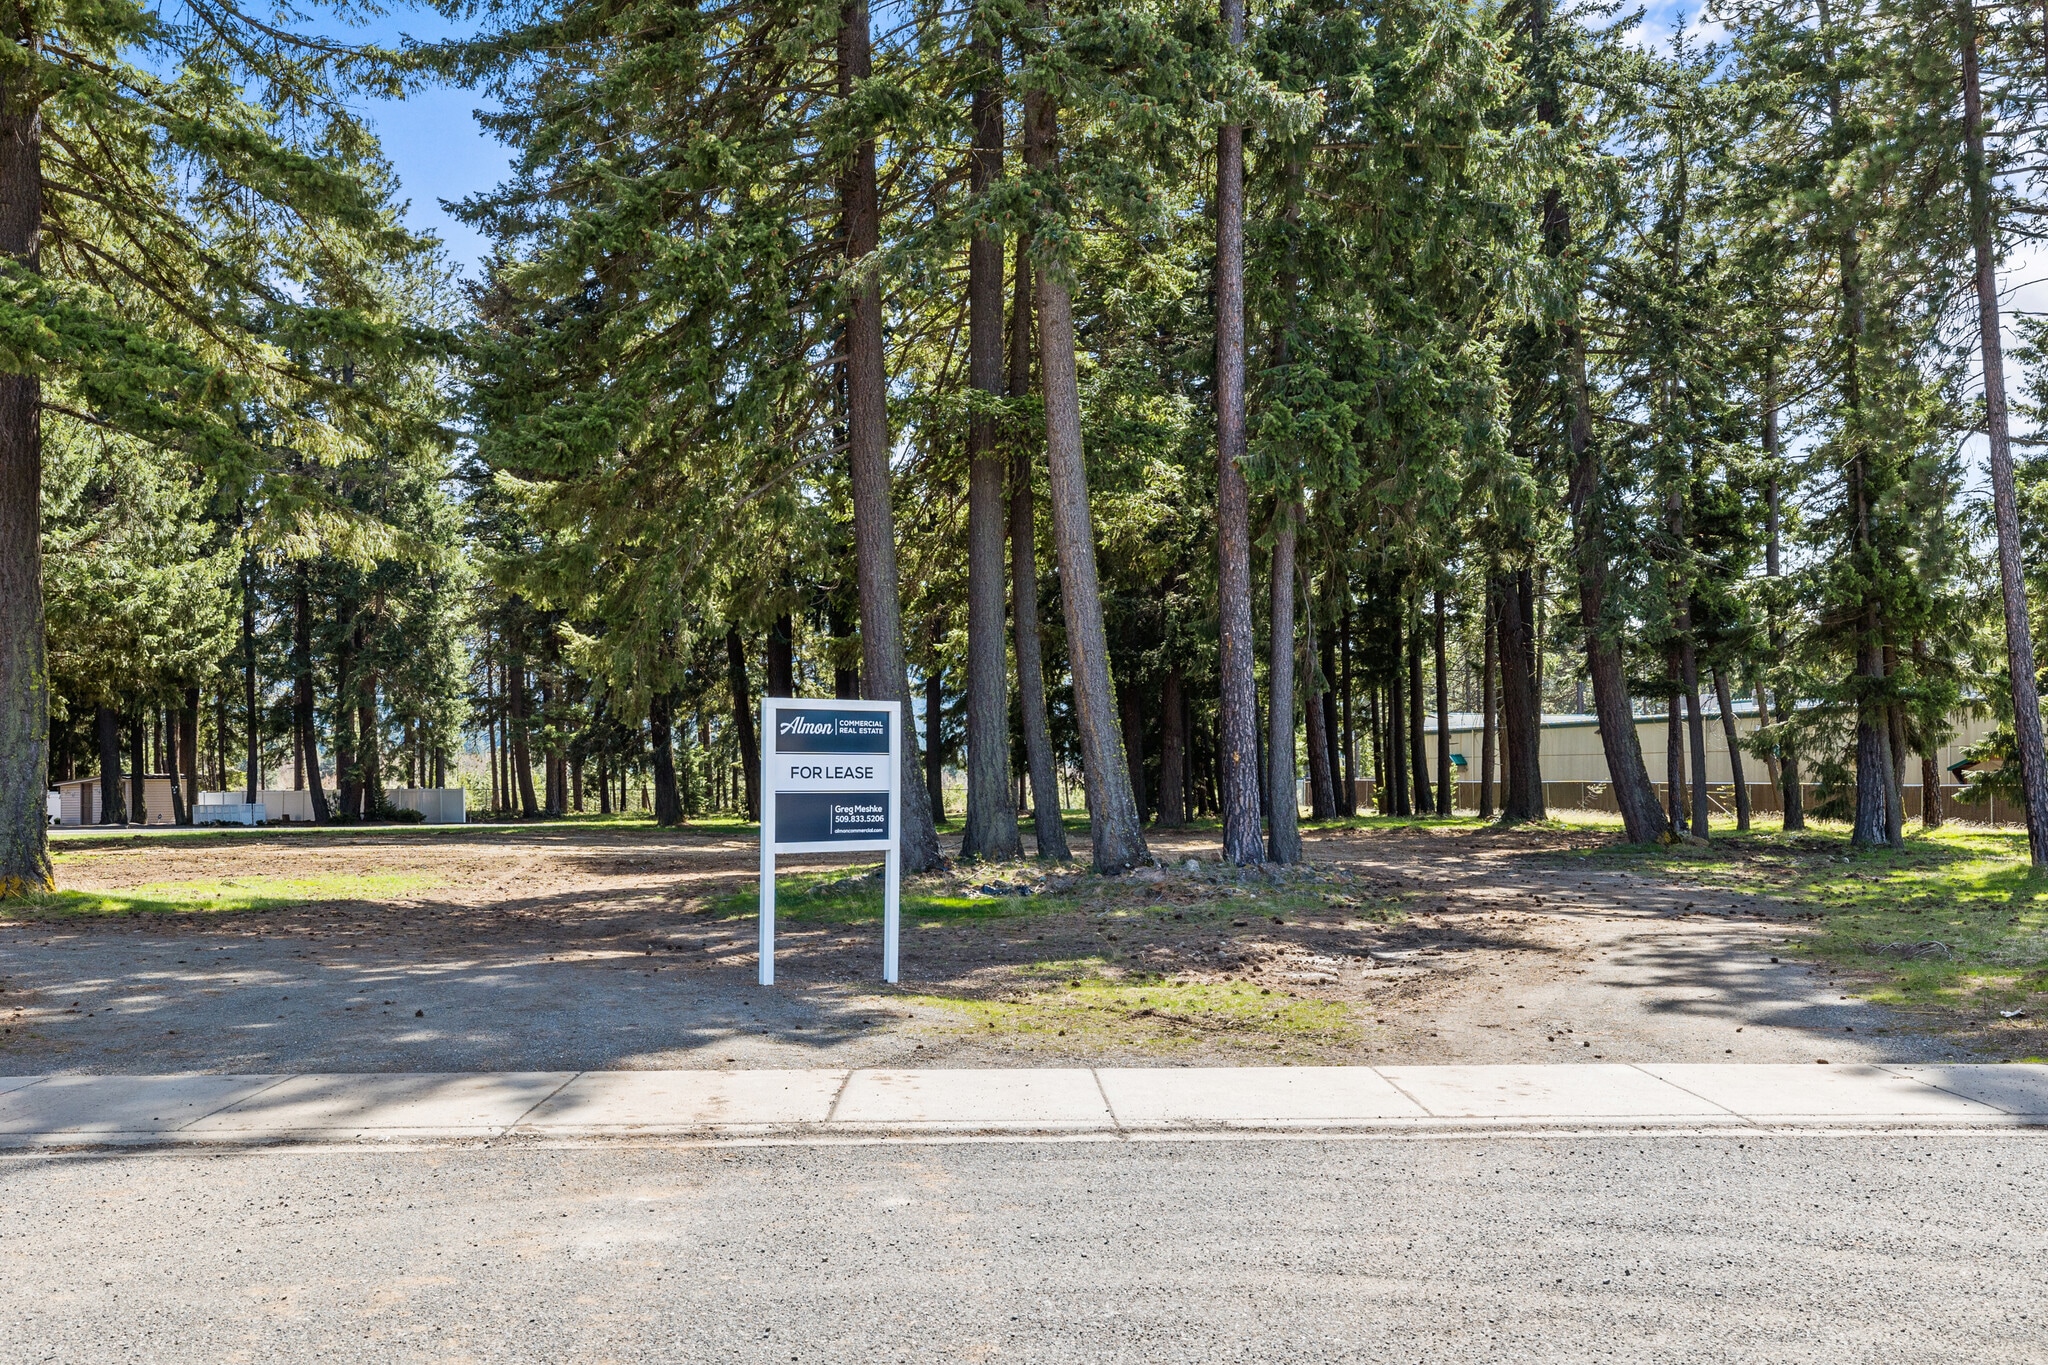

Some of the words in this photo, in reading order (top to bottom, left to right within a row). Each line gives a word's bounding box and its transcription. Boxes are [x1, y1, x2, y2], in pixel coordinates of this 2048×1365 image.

[780, 716, 834, 735] Almon
[791, 767, 822, 779] FOR
[826, 767, 873, 779] LEASE
[835, 805, 854, 815] Greg
[855, 805, 883, 813] Meshke
[835, 815, 885, 823] 509.833.5206
